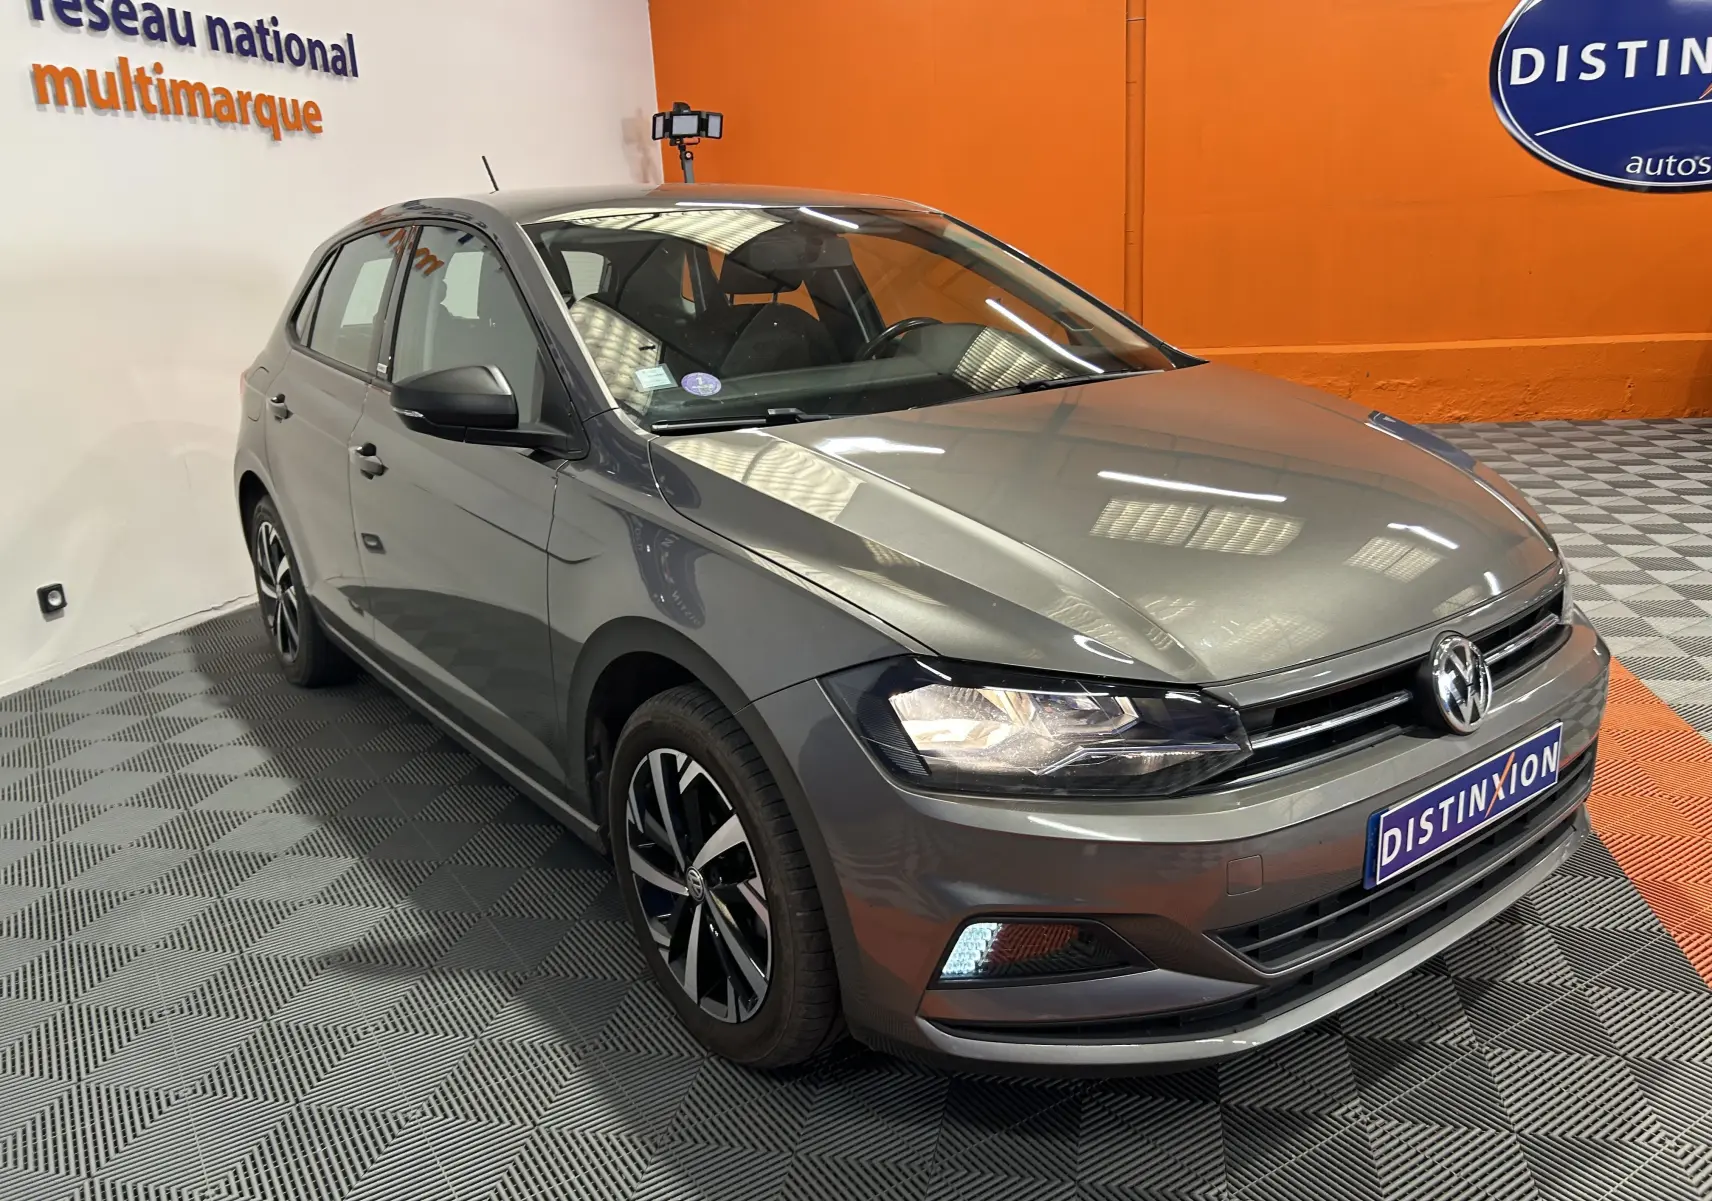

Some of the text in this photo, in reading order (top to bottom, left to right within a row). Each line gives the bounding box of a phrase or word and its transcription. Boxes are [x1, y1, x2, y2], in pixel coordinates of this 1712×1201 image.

[206, 15, 358, 78] national
[32, 56, 323, 141] multimarque
[1625, 154, 1711, 176] autos
[1381, 741, 1558, 867] DISTINXION
